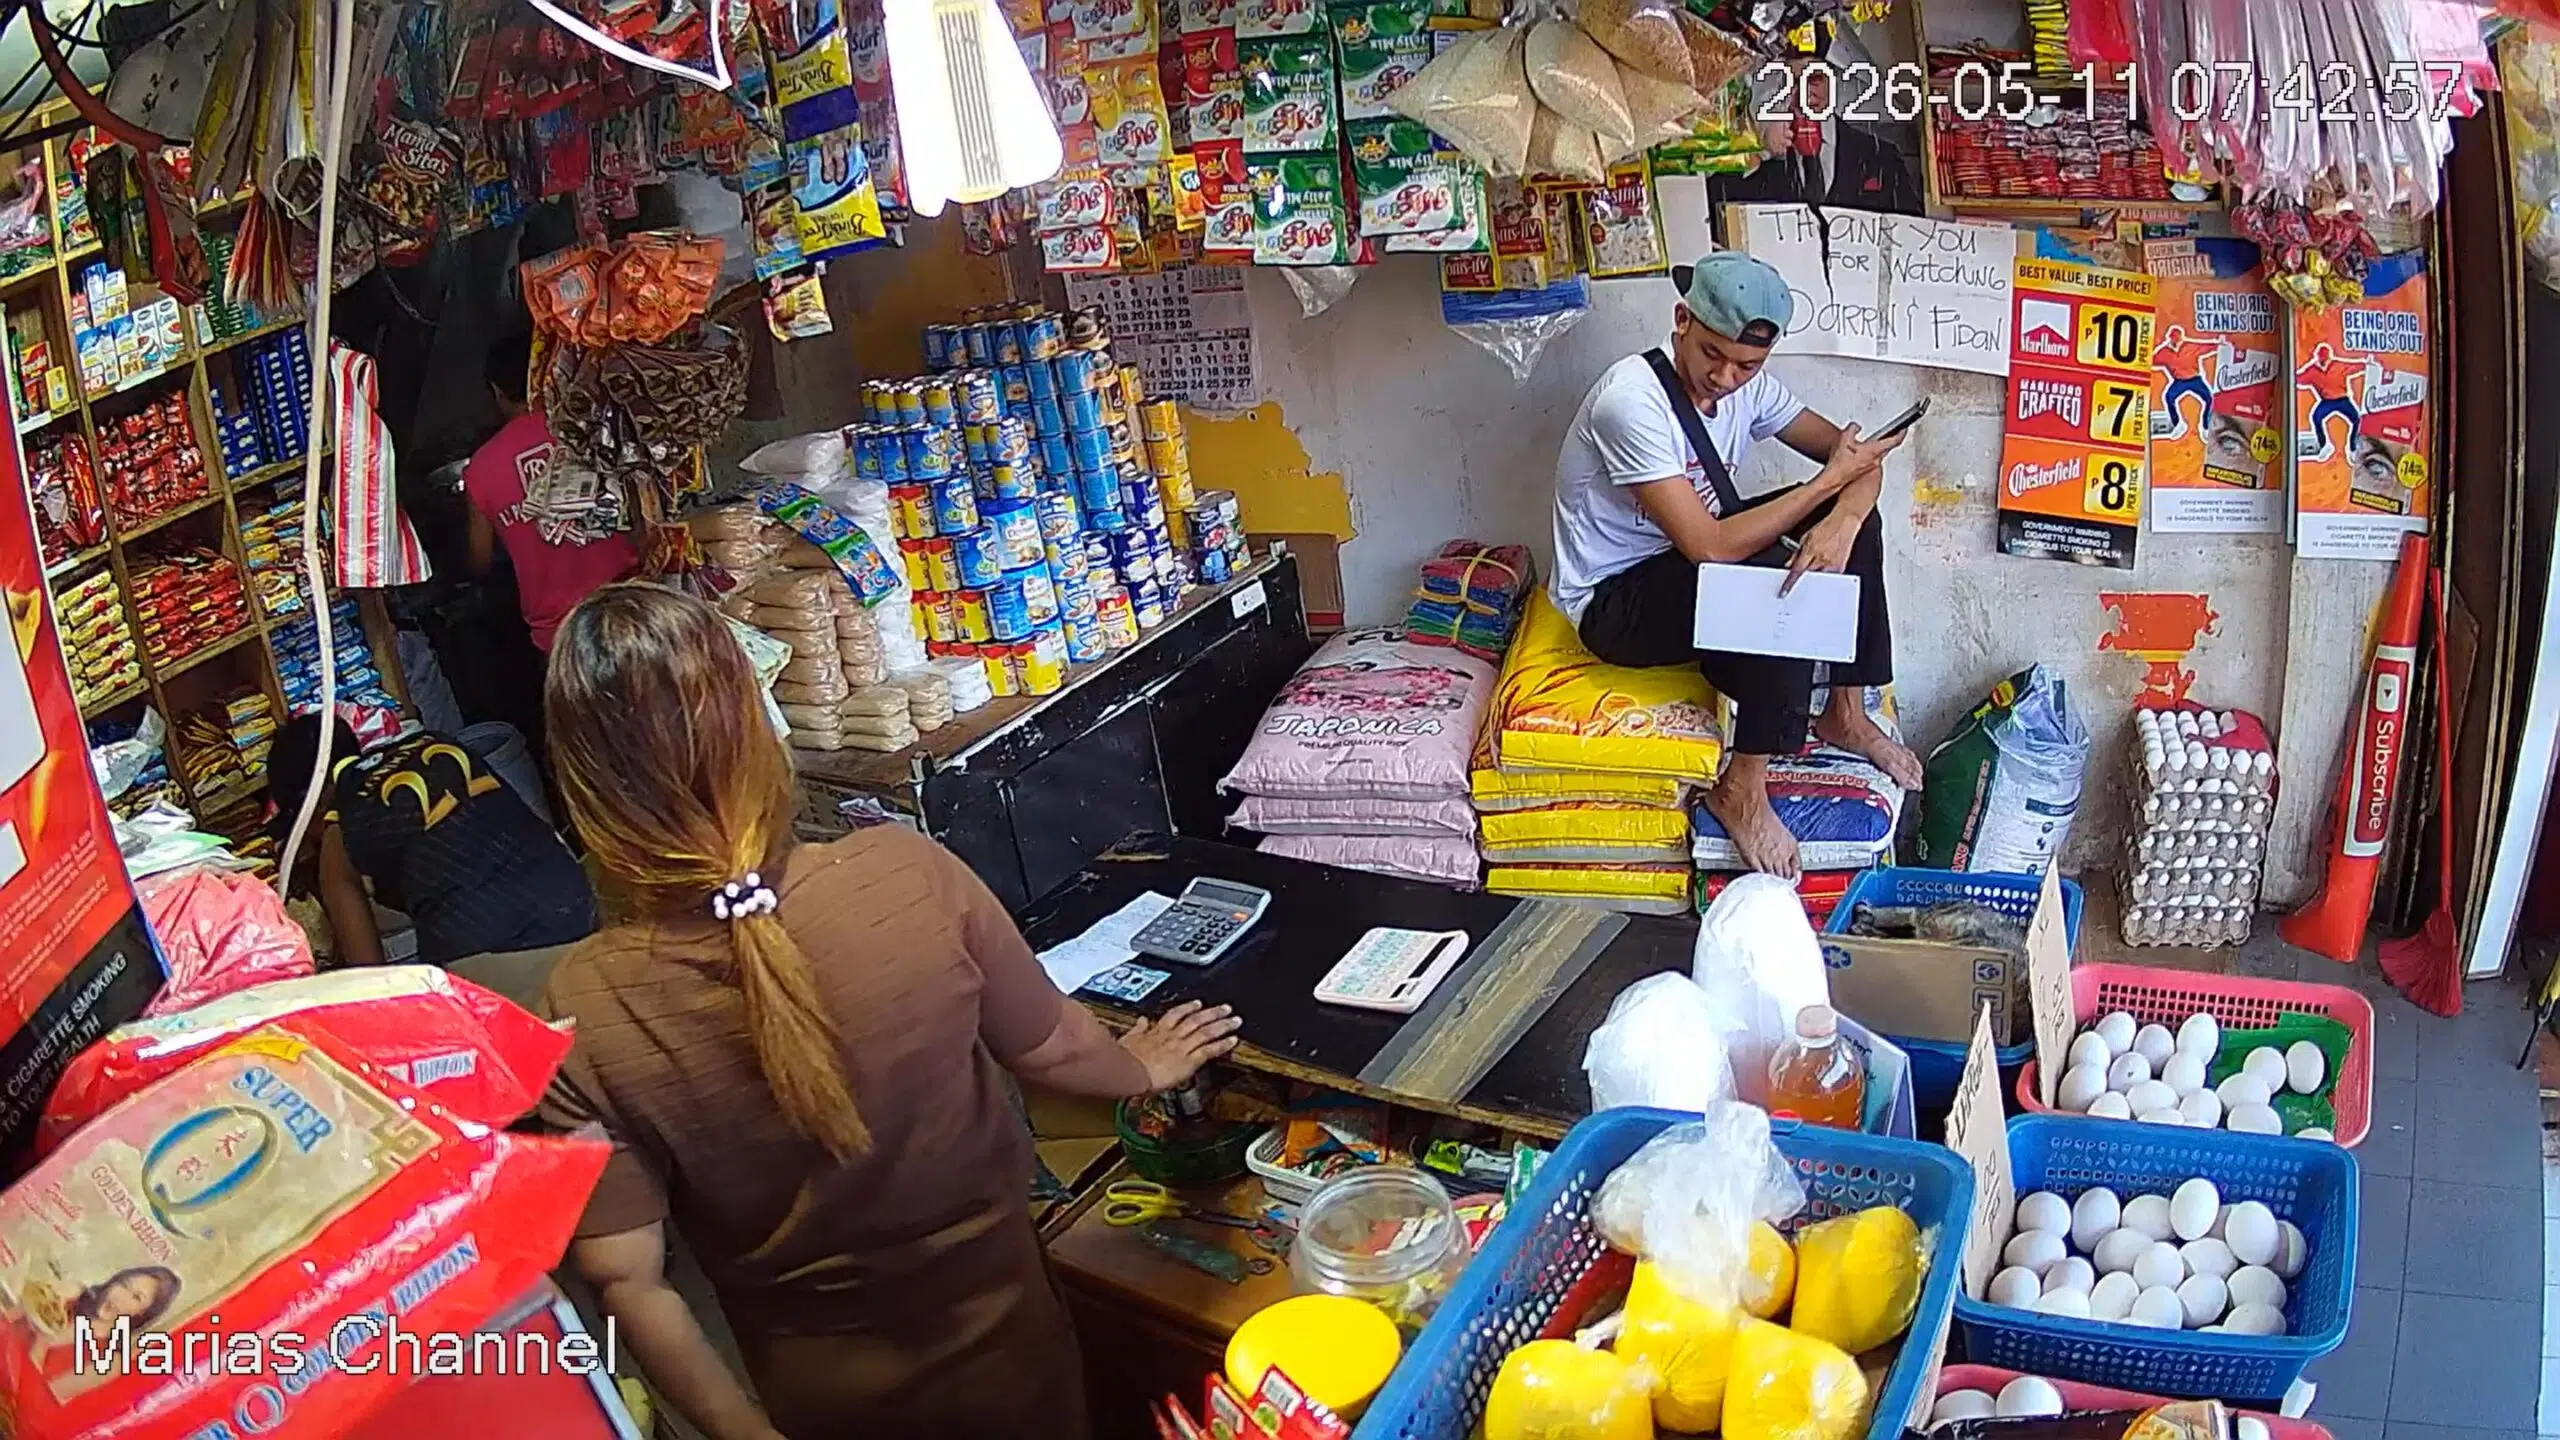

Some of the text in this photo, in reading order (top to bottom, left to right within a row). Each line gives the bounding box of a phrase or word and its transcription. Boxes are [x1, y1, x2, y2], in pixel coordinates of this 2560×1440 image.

[852, 27, 880, 50] Surf
[383, 123, 437, 153] Mama
[1827, 251, 1871, 271] FOR
[2019, 265, 2046, 279] BEST
[2087, 274, 2113, 289] BEST
[2116, 278, 2151, 295] PRICE!
[2196, 293, 2235, 312] BEING
[2196, 312, 2274, 332] STANDS OUT
[2344, 311, 2383, 331] BEING
[2021, 333, 2069, 357] Marlboro
[2345, 331, 2424, 351] STANDS OUT
[2018, 390, 2081, 427] CRAFTED
[2009, 458, 2081, 497] Chesterfield
[1265, 713, 1444, 737] JAPONICA
[2367, 719, 2396, 831] Subscribe
[8, 1014, 75, 1097] CIGARETTE
[71, 951, 127, 1020] SMOKING
[234, 1066, 332, 1154] SUPER
[91, 1163, 173, 1263] GOLDEN BIHON
